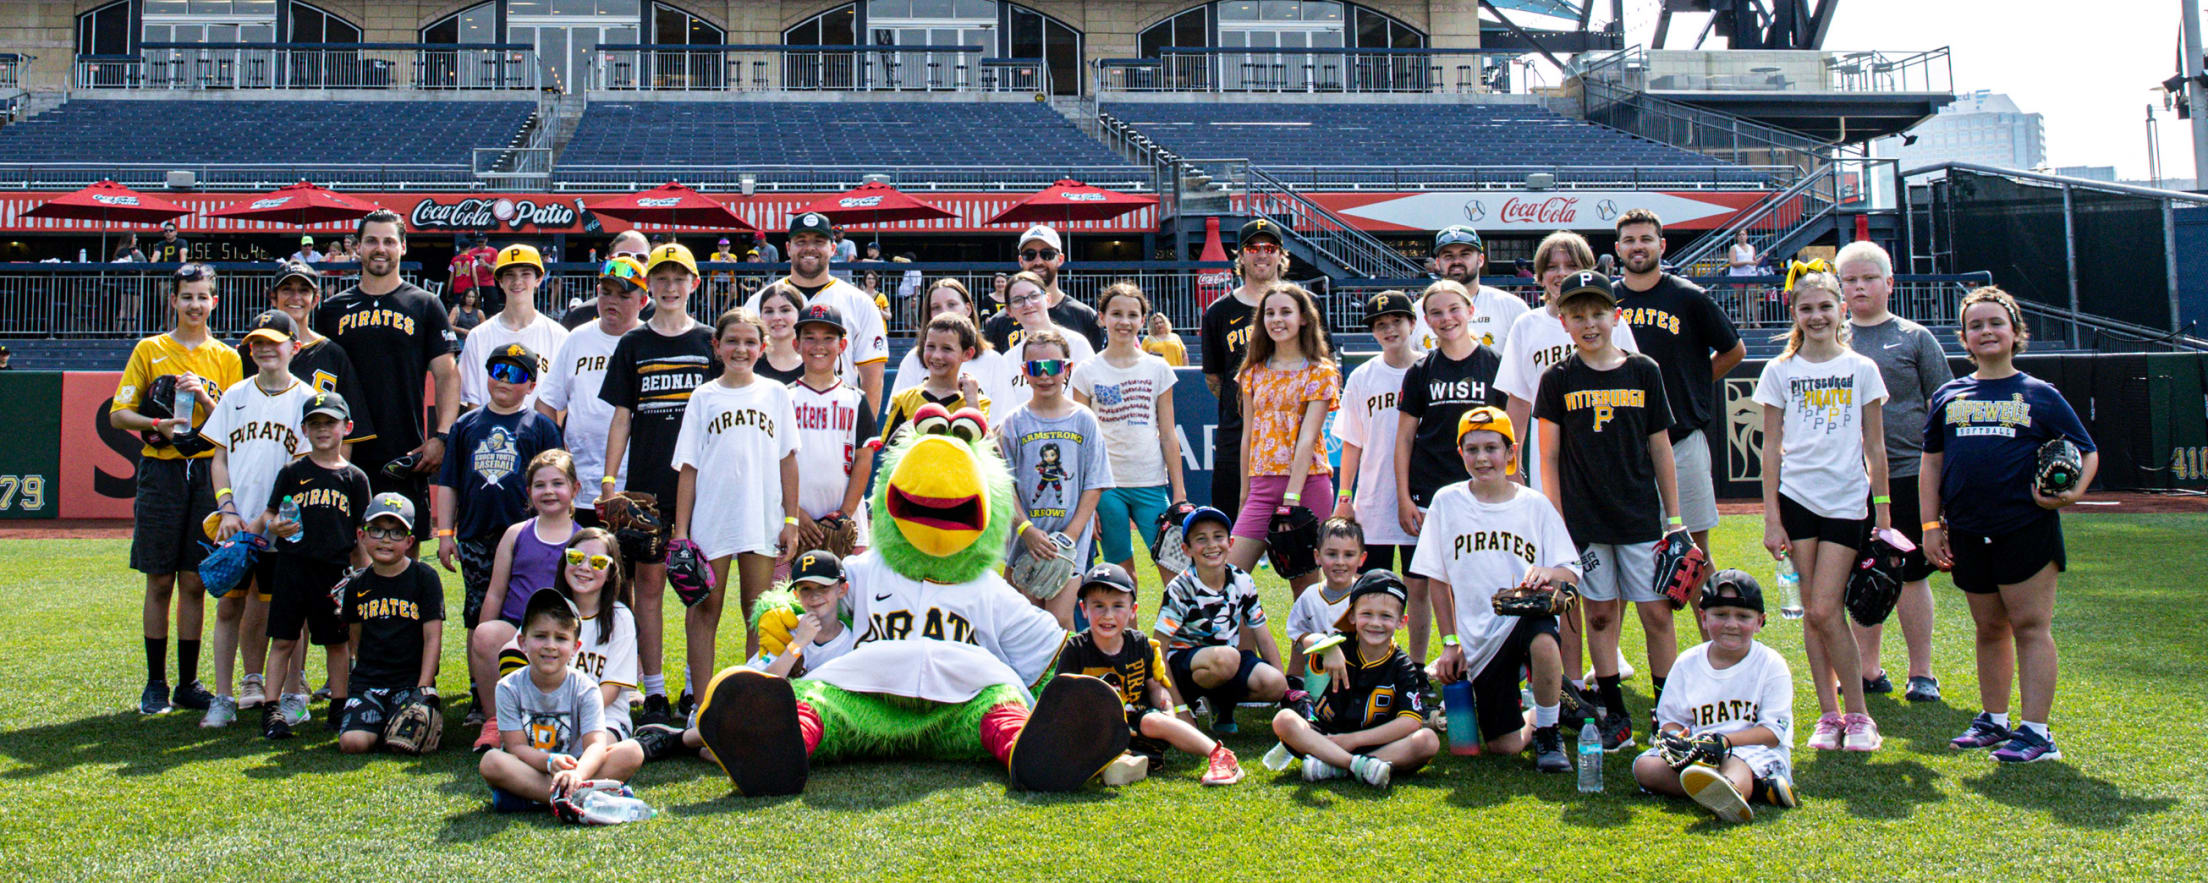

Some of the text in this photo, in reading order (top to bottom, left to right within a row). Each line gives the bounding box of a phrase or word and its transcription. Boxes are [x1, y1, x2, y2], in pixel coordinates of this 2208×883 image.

[411, 198, 494, 227] Coca-Cola
[508, 200, 575, 227] Patio
[1500, 197, 1579, 223] Coca-Cola
[1256, 219, 1267, 230] P
[164, 245, 175, 262] P
[510, 248, 520, 261] P
[665, 247, 676, 258] P
[1579, 272, 1593, 287] P
[1377, 295, 1389, 311] P
[258, 314, 273, 327] P
[338, 309, 415, 336] PIRATES
[641, 373, 703, 392] BEDNAR
[1429, 381, 1485, 400] WISH
[1791, 374, 1854, 393] PITTSBURGH
[1564, 389, 1646, 412] PITTSBURGH
[1593, 405, 1614, 432] P
[1945, 400, 2032, 428] HOPEWELL
[707, 408, 775, 444] PIRATES
[1960, 427, 2012, 436] SOFTBALL
[229, 420, 299, 456] PIRATES
[1021, 431, 1084, 446] ARMSTRONG
[1454, 531, 1536, 564] PIRATES
[801, 555, 816, 573] P
[357, 597, 420, 620] PIRATES
[1361, 683, 1397, 729] P
